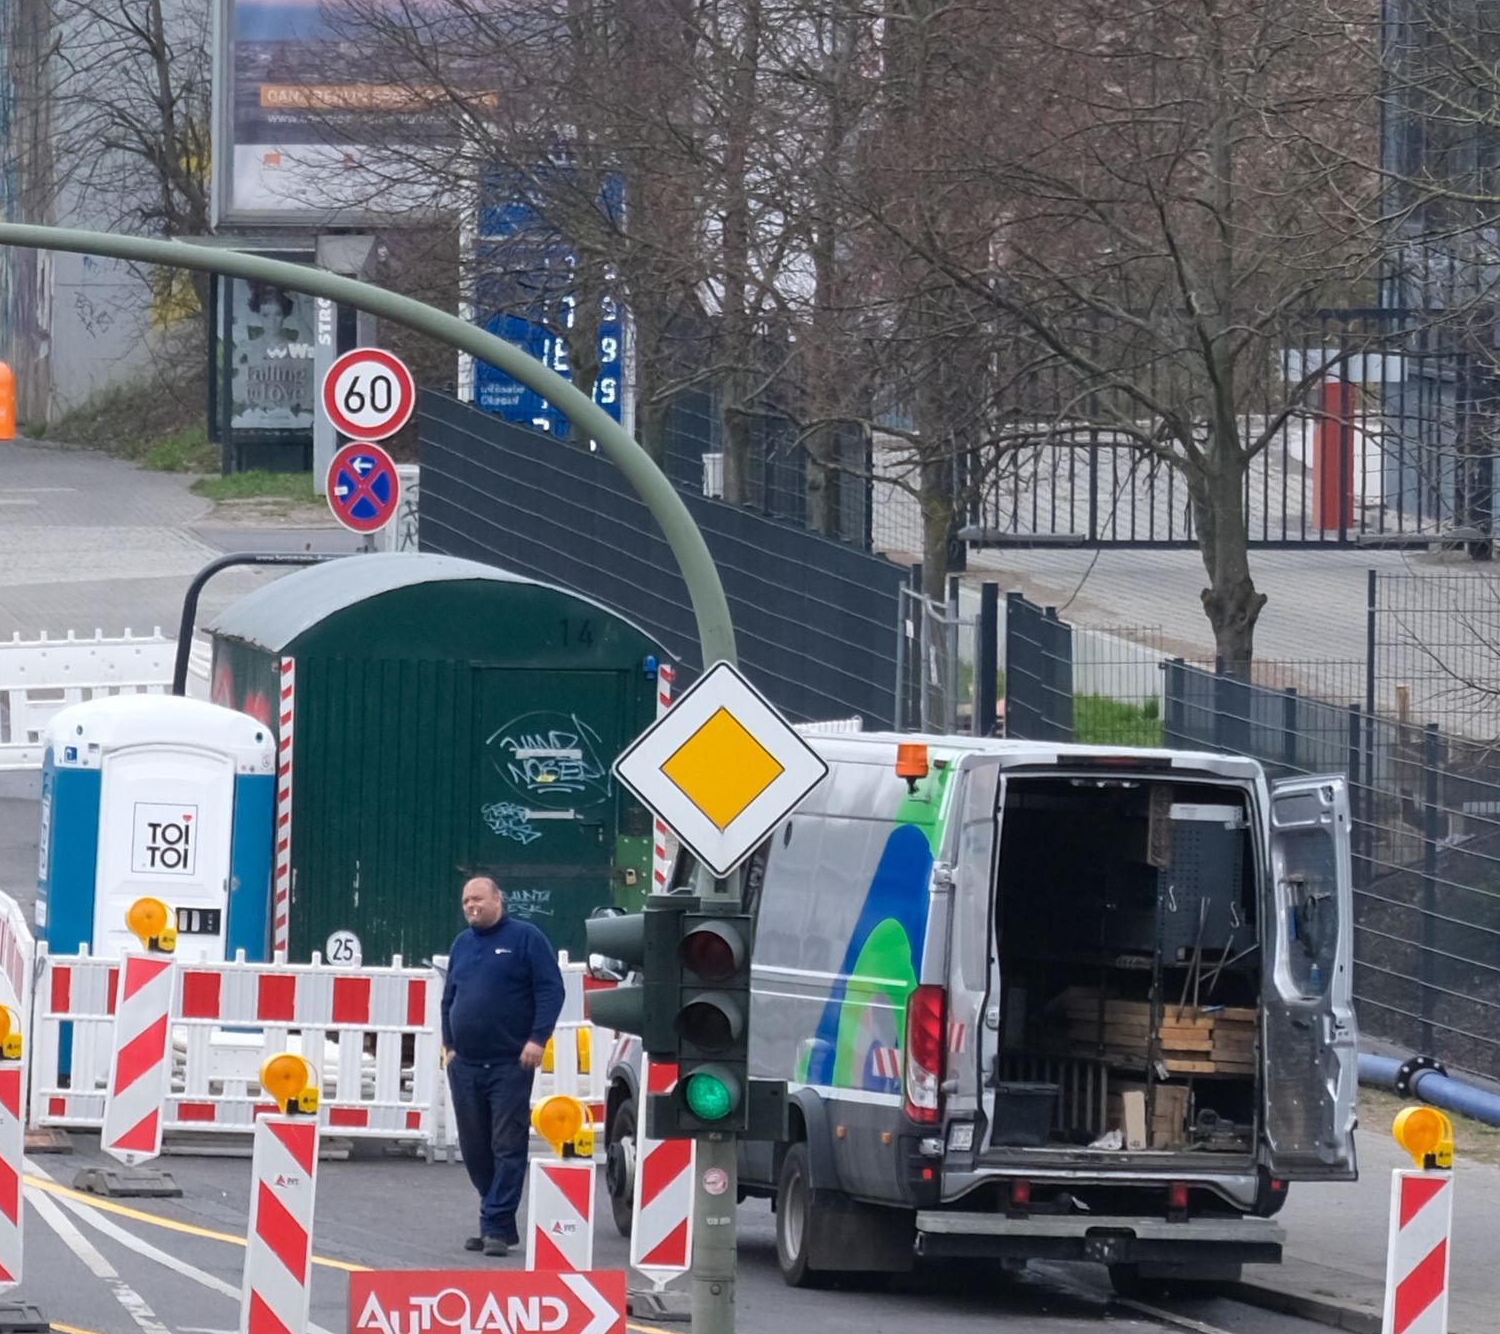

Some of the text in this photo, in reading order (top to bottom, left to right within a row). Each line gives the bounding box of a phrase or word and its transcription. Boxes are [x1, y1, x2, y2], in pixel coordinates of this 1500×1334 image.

[343, 375, 393, 416] 60
[147, 823, 190, 846] TOI
[146, 846, 189, 869] TOI
[333, 939, 354, 961] 25
